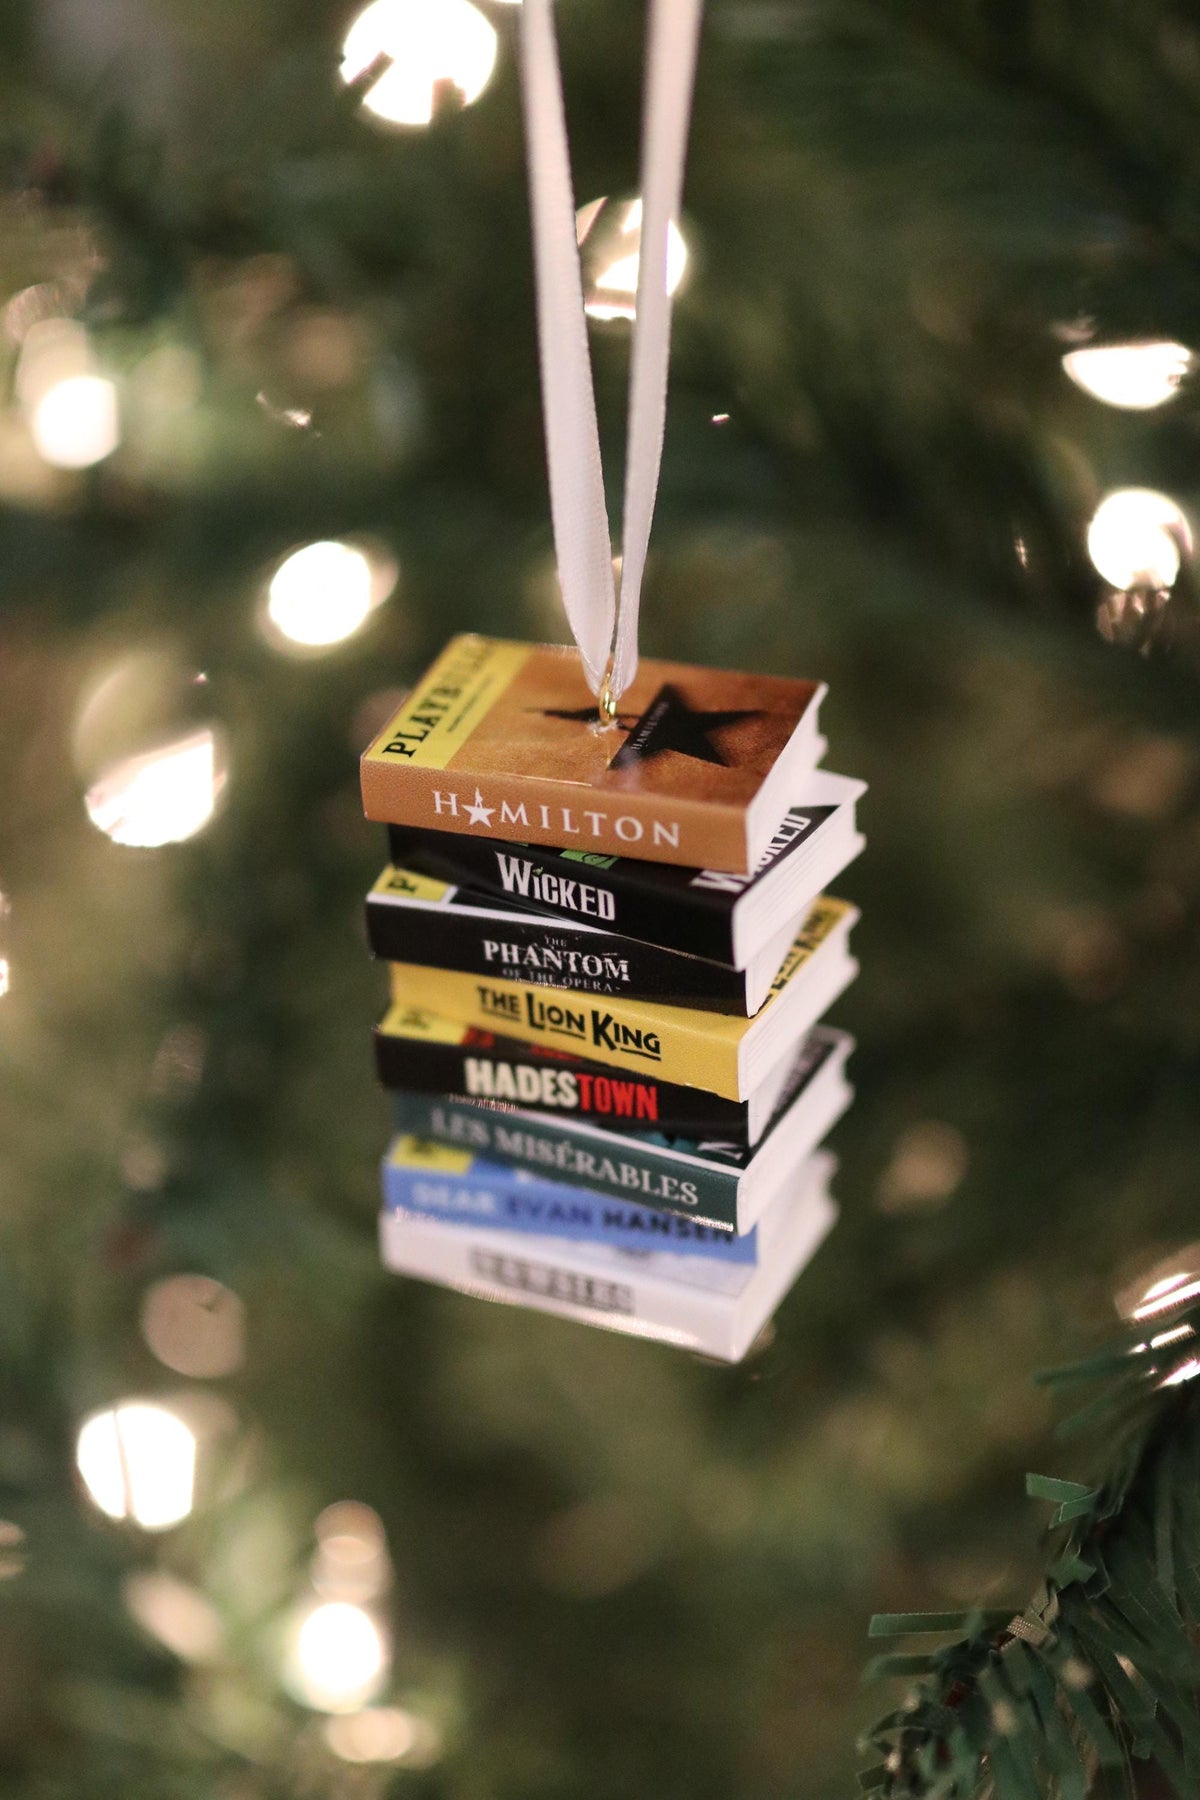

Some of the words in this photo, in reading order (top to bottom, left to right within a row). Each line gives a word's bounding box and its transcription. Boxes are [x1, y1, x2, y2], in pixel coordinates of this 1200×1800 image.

[483, 938, 631, 983] PHANTOM
[545, 935, 567, 947] THE
[562, 976, 613, 993] OPERA
[477, 985, 521, 1014] THE
[525, 992, 586, 1034] LION
[591, 1010, 662, 1052] KING
[430, 1107, 491, 1147] LES
[494, 1126, 699, 1205] MISÉRABLES
